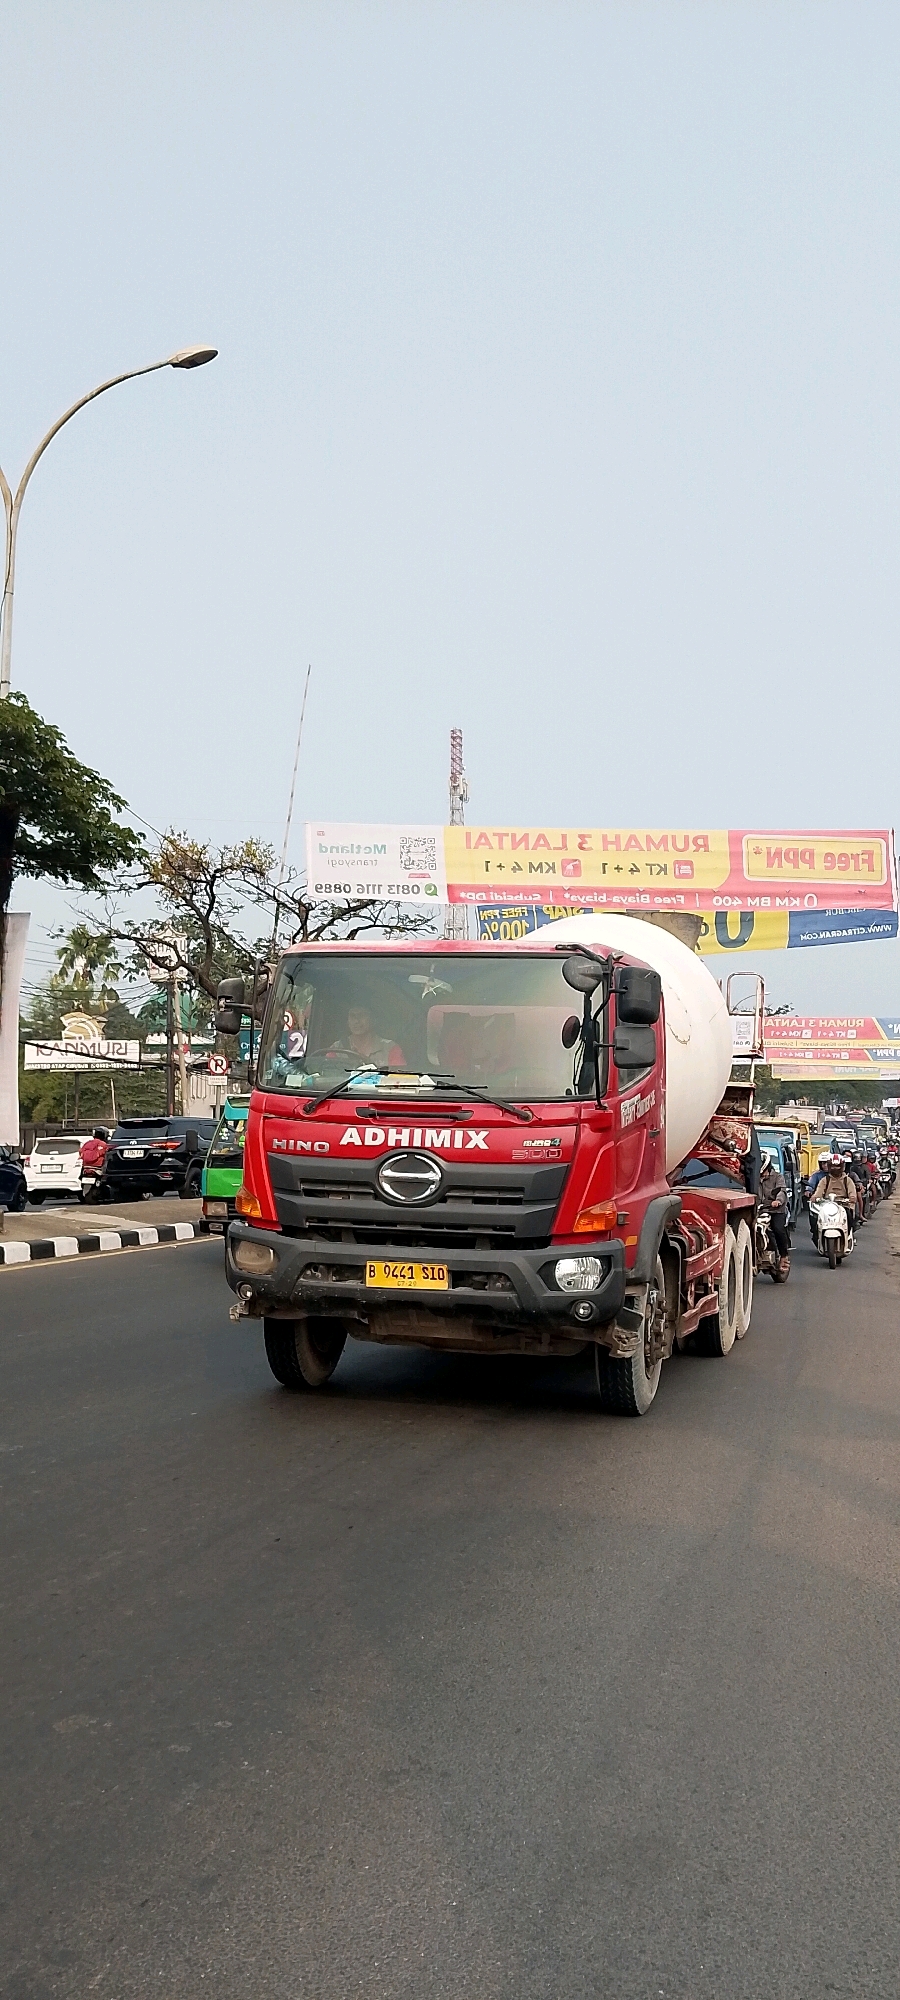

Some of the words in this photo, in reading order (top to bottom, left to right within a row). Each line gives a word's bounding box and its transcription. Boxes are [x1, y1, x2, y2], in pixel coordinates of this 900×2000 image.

[272, 1138, 330, 1153] HINO
[339, 1127, 490, 1150] ADHIMIX
[512, 1148, 563, 1160] 500
[368, 1264, 376, 1278] B
[383, 1264, 415, 1280] 9441
